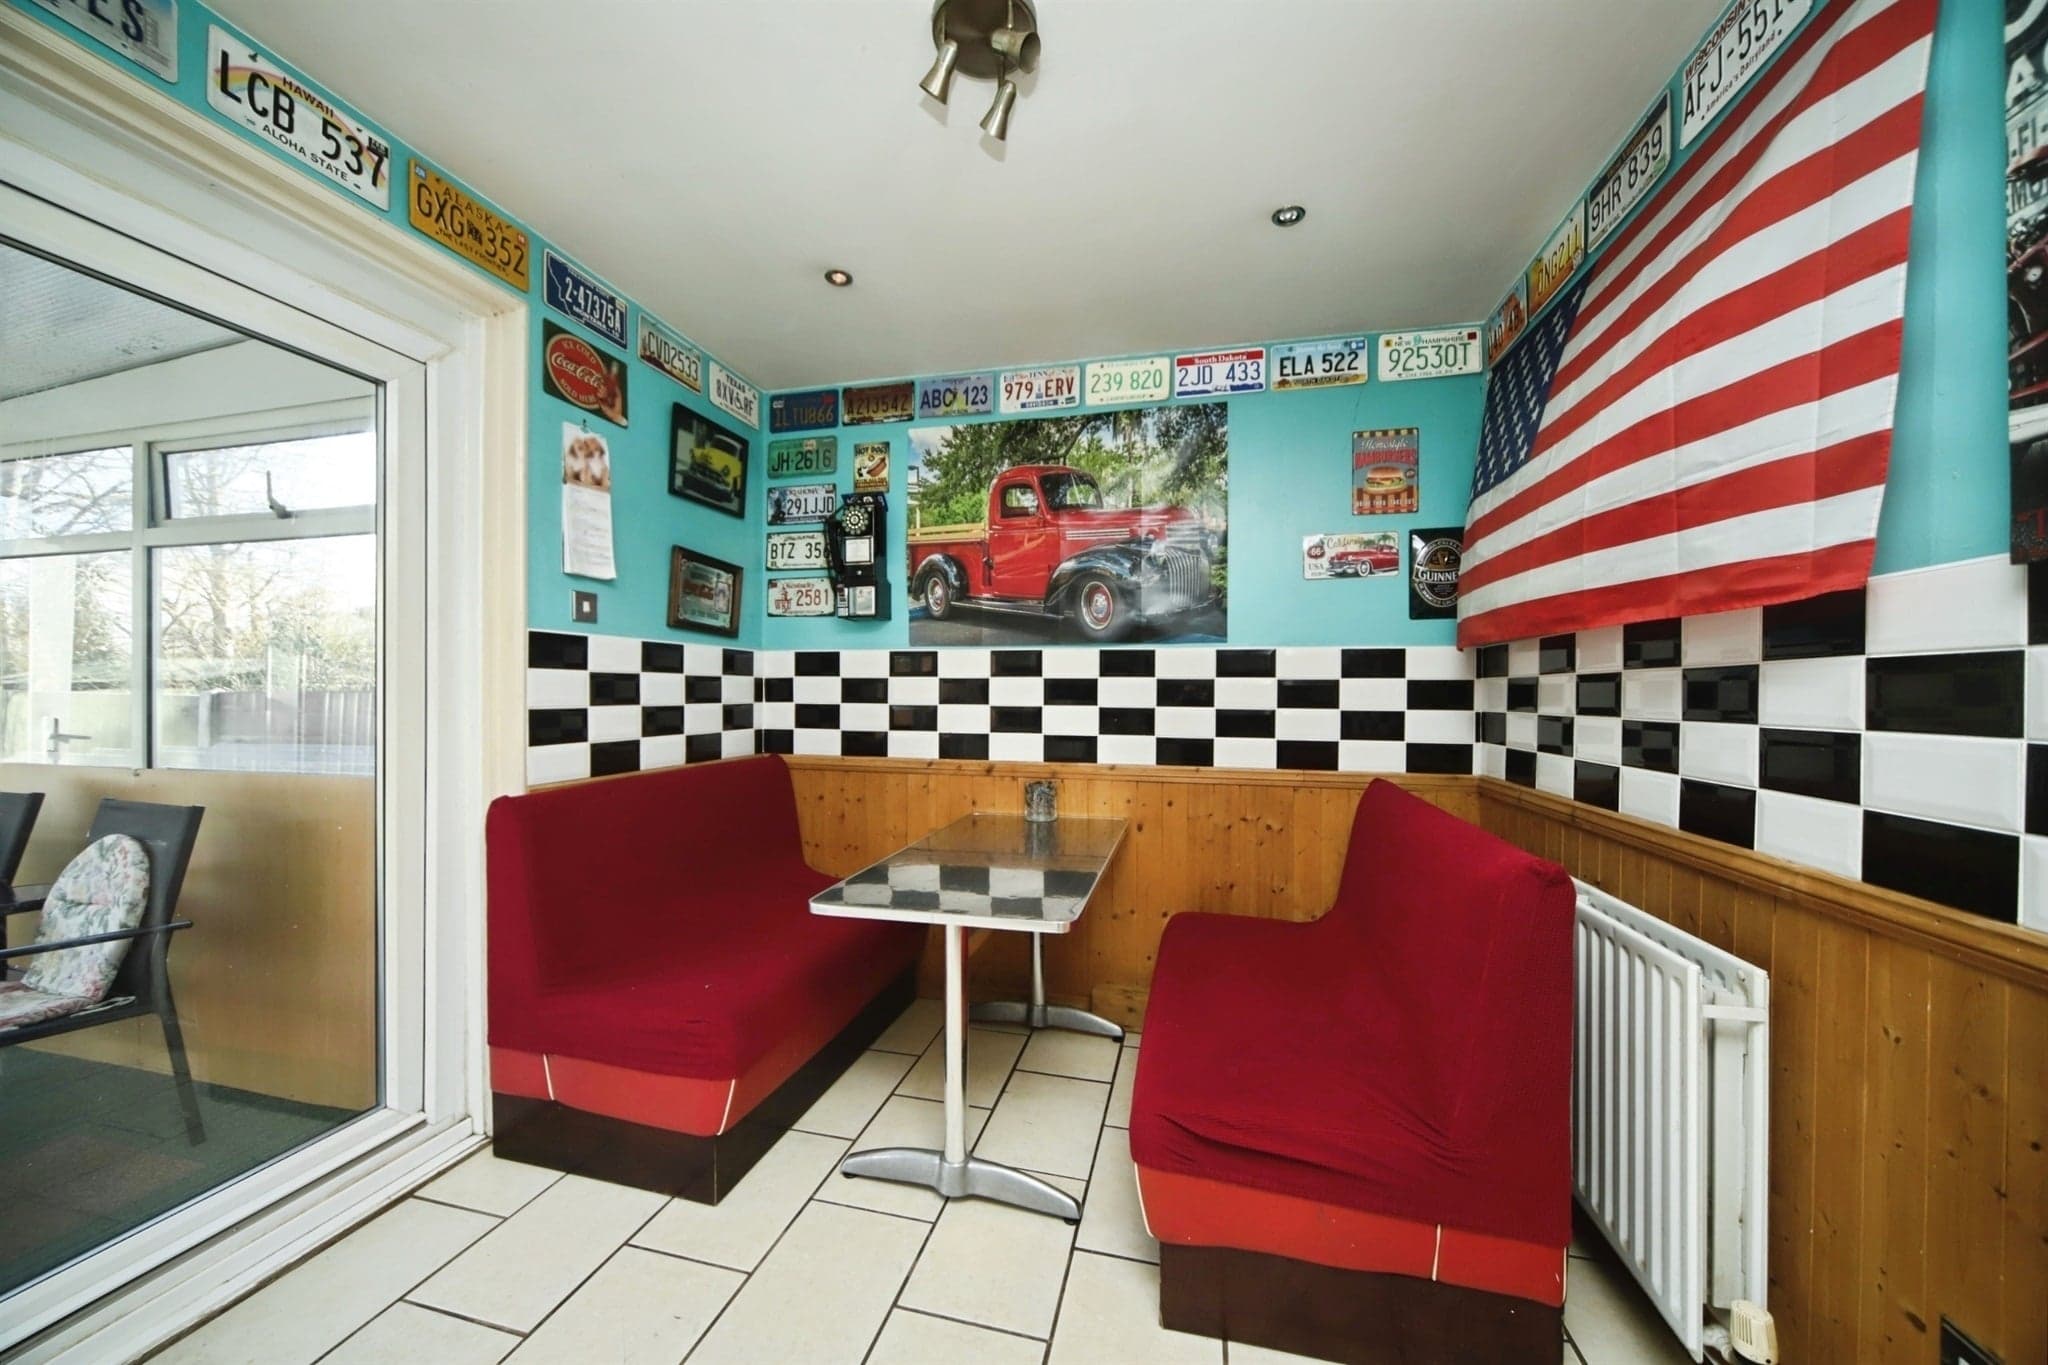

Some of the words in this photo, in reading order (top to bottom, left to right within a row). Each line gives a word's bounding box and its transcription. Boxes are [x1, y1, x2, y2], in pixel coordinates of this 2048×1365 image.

[1684, 0, 1795, 126] AFJ-551
[283, 76, 334, 118] HAWAII
[220, 49, 295, 134] LCB
[322, 117, 386, 187] 537
[262, 124, 307, 157] ALOHA
[310, 153, 348, 182] STATE
[1591, 174, 1621, 233] 9HR
[1628, 124, 1662, 190] 839
[443, 187, 504, 233] ALASKA
[417, 183, 465, 238] GXG
[484, 226, 525, 277] 352
[1194, 356, 1218, 365] South
[1218, 353, 1248, 363] Dakota
[1279, 354, 1314, 377] ELA
[1322, 351, 1359, 373] 522
[1389, 343, 1472, 373] 92530T
[1091, 373, 1123, 394] 239
[1130, 369, 1162, 390] 820
[1178, 365, 1213, 387] 2JD
[1225, 360, 1261, 383] 433
[920, 389, 956, 409] ABC
[963, 385, 988, 406] 123
[1004, 381, 1033, 400] 979
[1045, 377, 1075, 398] ERV
[770, 543, 795, 559] BTZ
[1418, 570, 1458, 582] GUINNE
[796, 588, 829, 607] 2581
